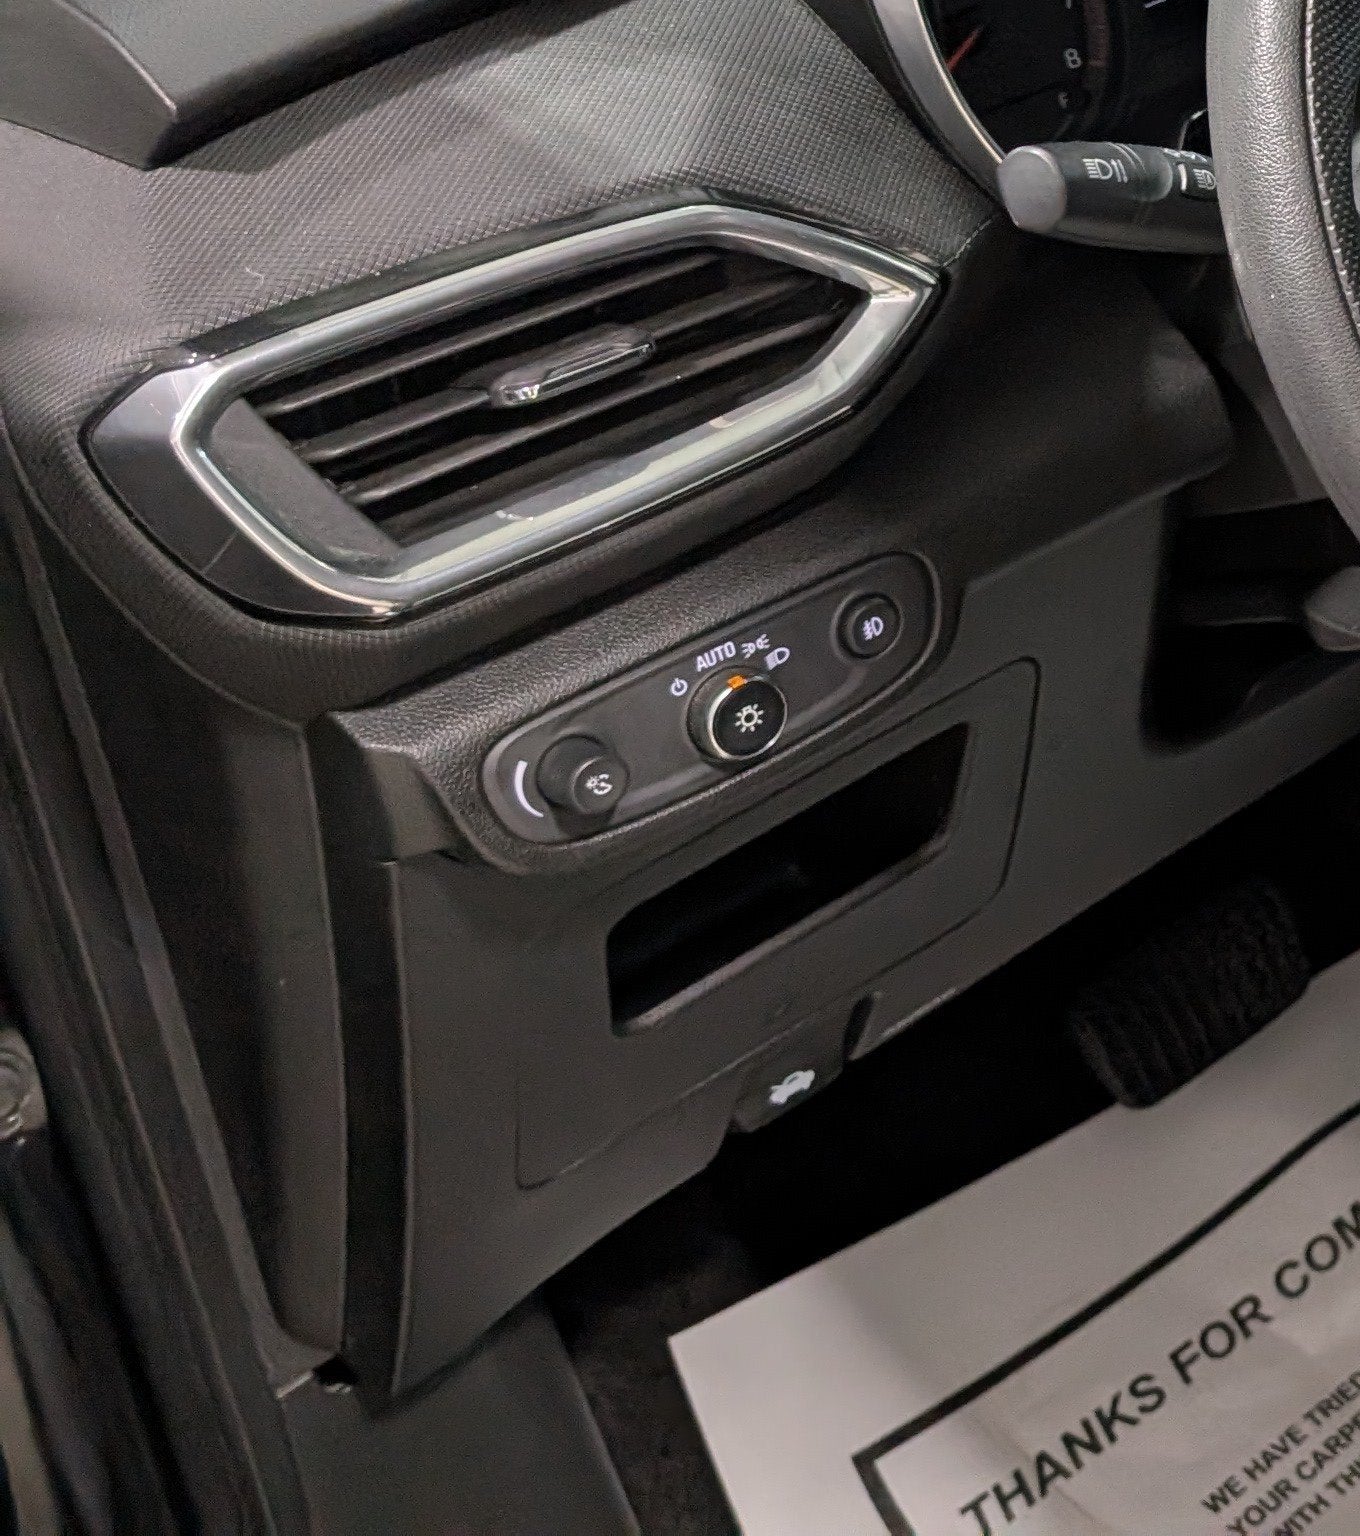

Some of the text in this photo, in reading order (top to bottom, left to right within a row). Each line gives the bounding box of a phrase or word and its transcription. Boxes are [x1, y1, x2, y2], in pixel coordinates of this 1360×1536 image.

[1063, 48, 1082, 69] 8
[696, 640, 735, 671] AUTO
[960, 1372, 1168, 1536] THANKS
[1169, 1293, 1272, 1386] FOR
[1201, 1475, 1247, 1514] WE
[1243, 1424, 1308, 1482] HAVE
[1226, 1477, 1299, 1536] YOUR
